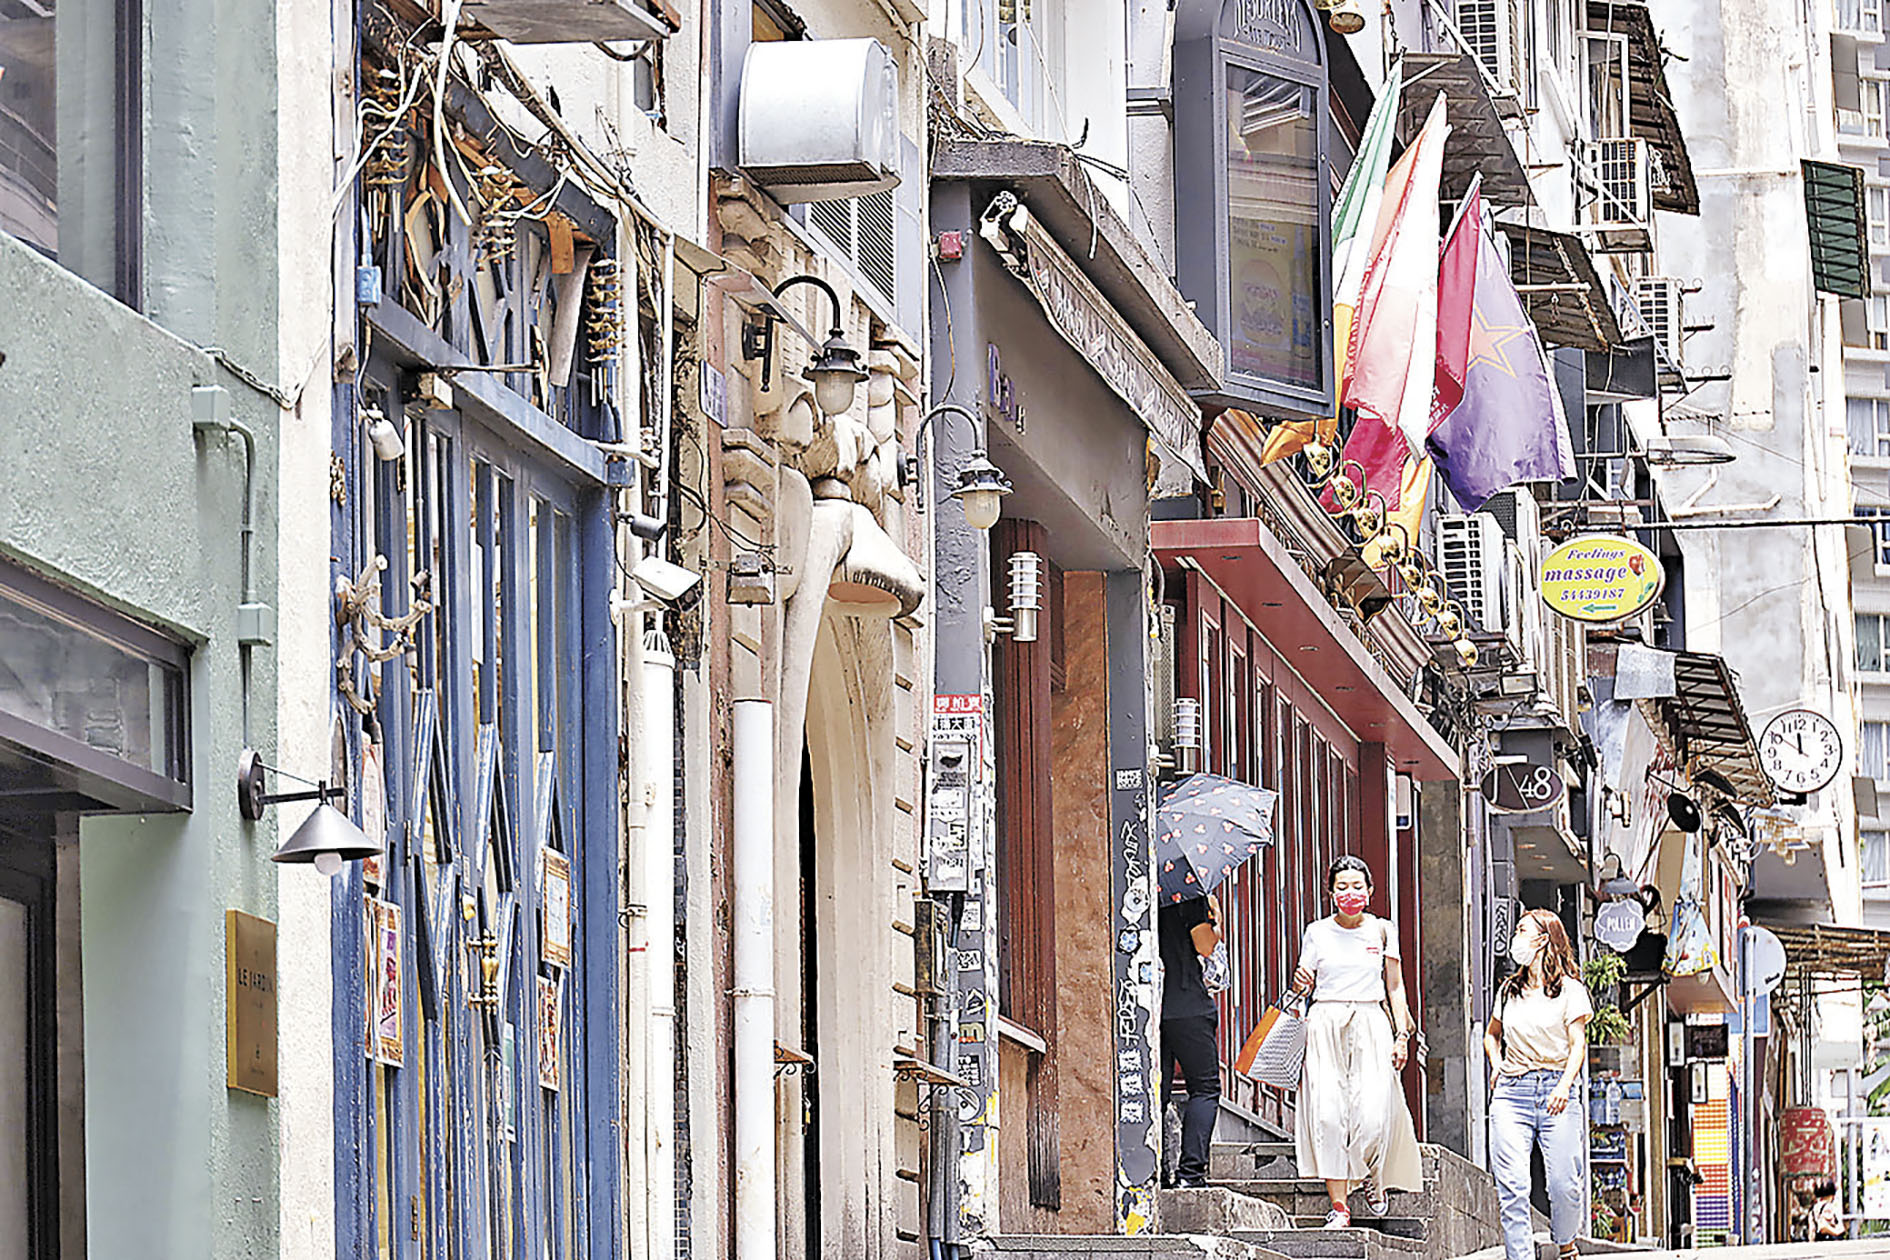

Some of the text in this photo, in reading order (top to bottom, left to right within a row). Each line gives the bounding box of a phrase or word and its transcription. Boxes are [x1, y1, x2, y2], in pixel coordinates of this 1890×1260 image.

[1567, 548, 1626, 560] Feelings
[1545, 567, 1627, 583] massage
[1561, 588, 1625, 601] 54439187
[1780, 719, 1791, 733] 11
[1794, 719, 1806, 730] 12
[1770, 731, 1783, 744] 10
[1820, 730, 1828, 741] 2
[1767, 747, 1776, 758] 9
[1824, 744, 1832, 755] 3
[1773, 760, 1781, 770] 8
[1820, 758, 1828, 767] 4
[1784, 769, 1792, 780] 7
[1796, 772, 1805, 783] 6
[1810, 768, 1819, 779] 5
[1519, 766, 1552, 800] 48
[238, 967, 248, 988] LE
